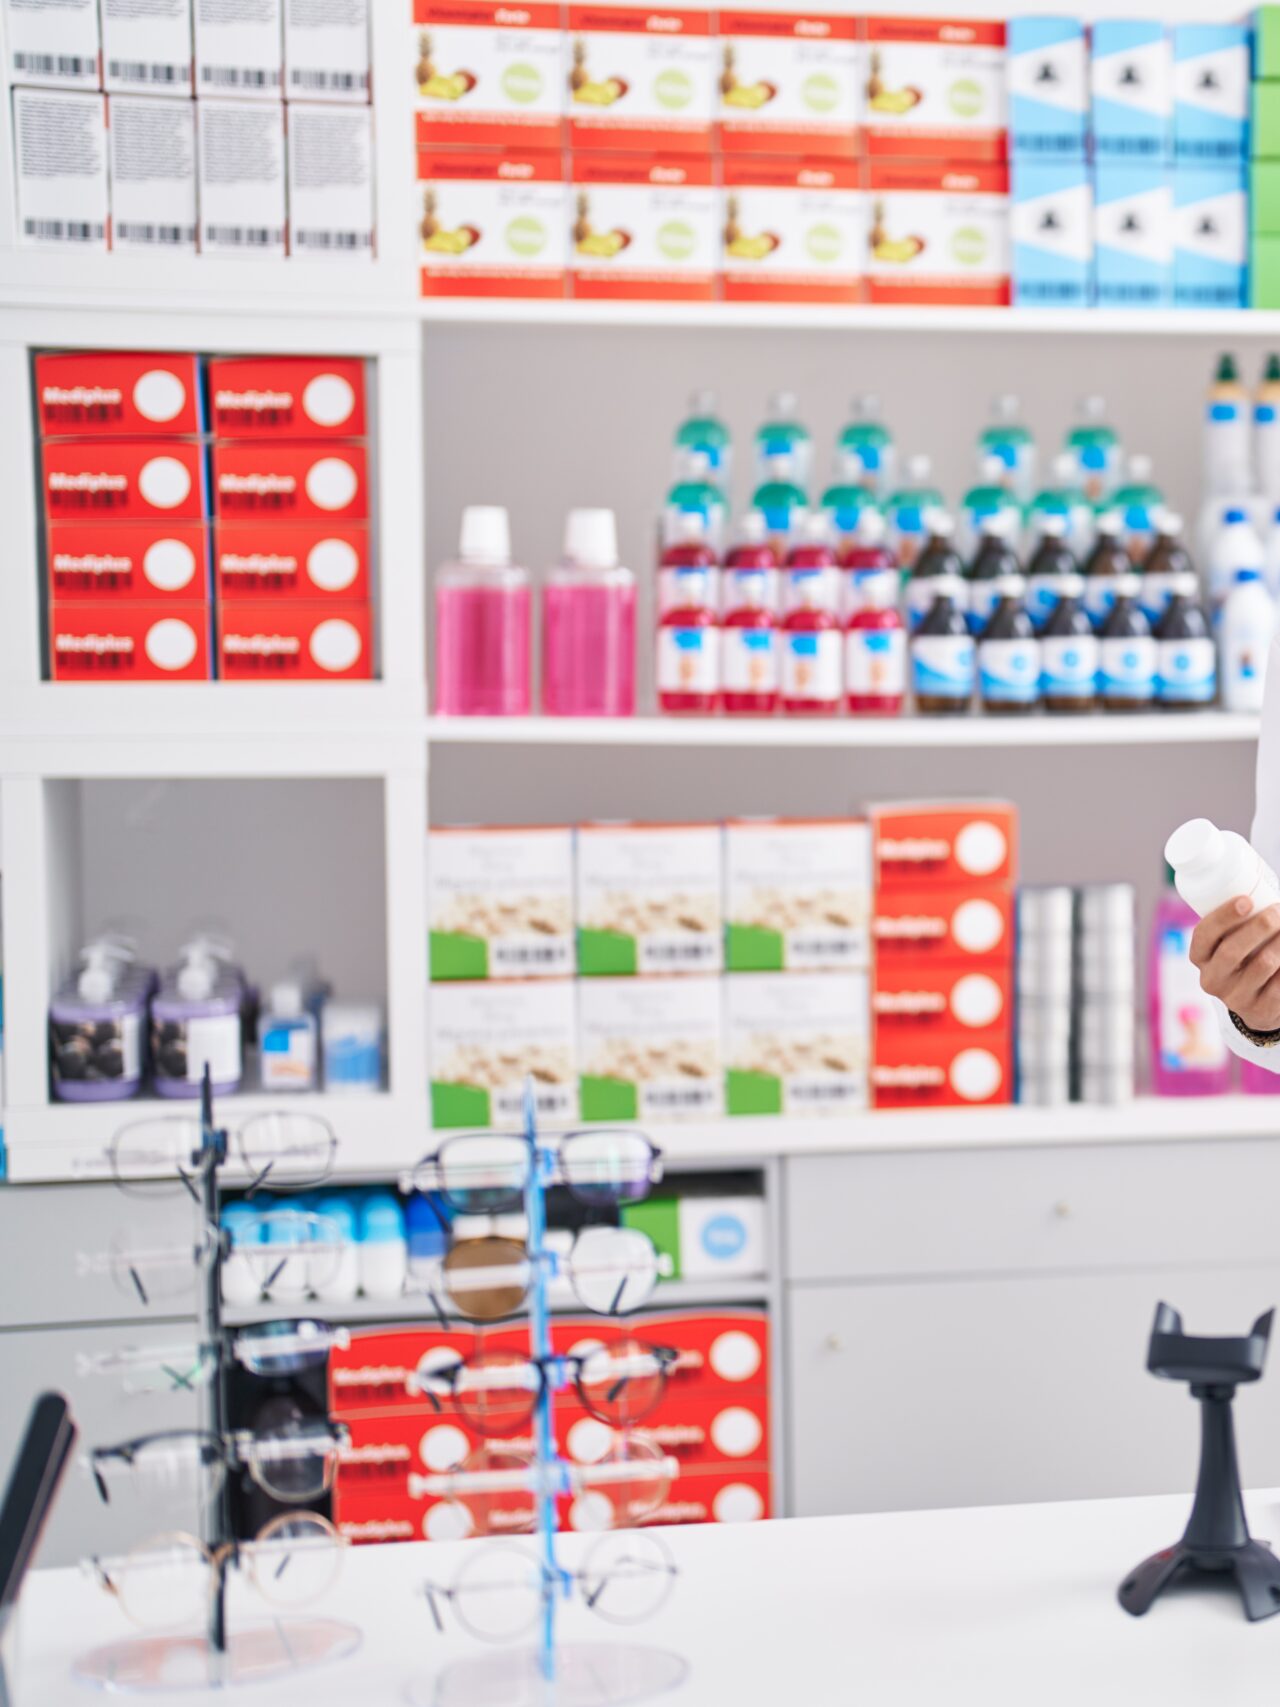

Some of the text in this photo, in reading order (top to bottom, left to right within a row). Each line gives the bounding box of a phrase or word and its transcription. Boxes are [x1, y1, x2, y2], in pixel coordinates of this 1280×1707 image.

[43, 386, 122, 406] Mediplus
[215, 390, 293, 410] Mediplus
[49, 473, 127, 493] Mediplus
[219, 474, 296, 495] Mediplus
[54, 554, 131, 574] Mediplus
[220, 554, 297, 575] Mediplus
[56, 634, 134, 654] Mediplus
[223, 635, 299, 655] Mediplus
